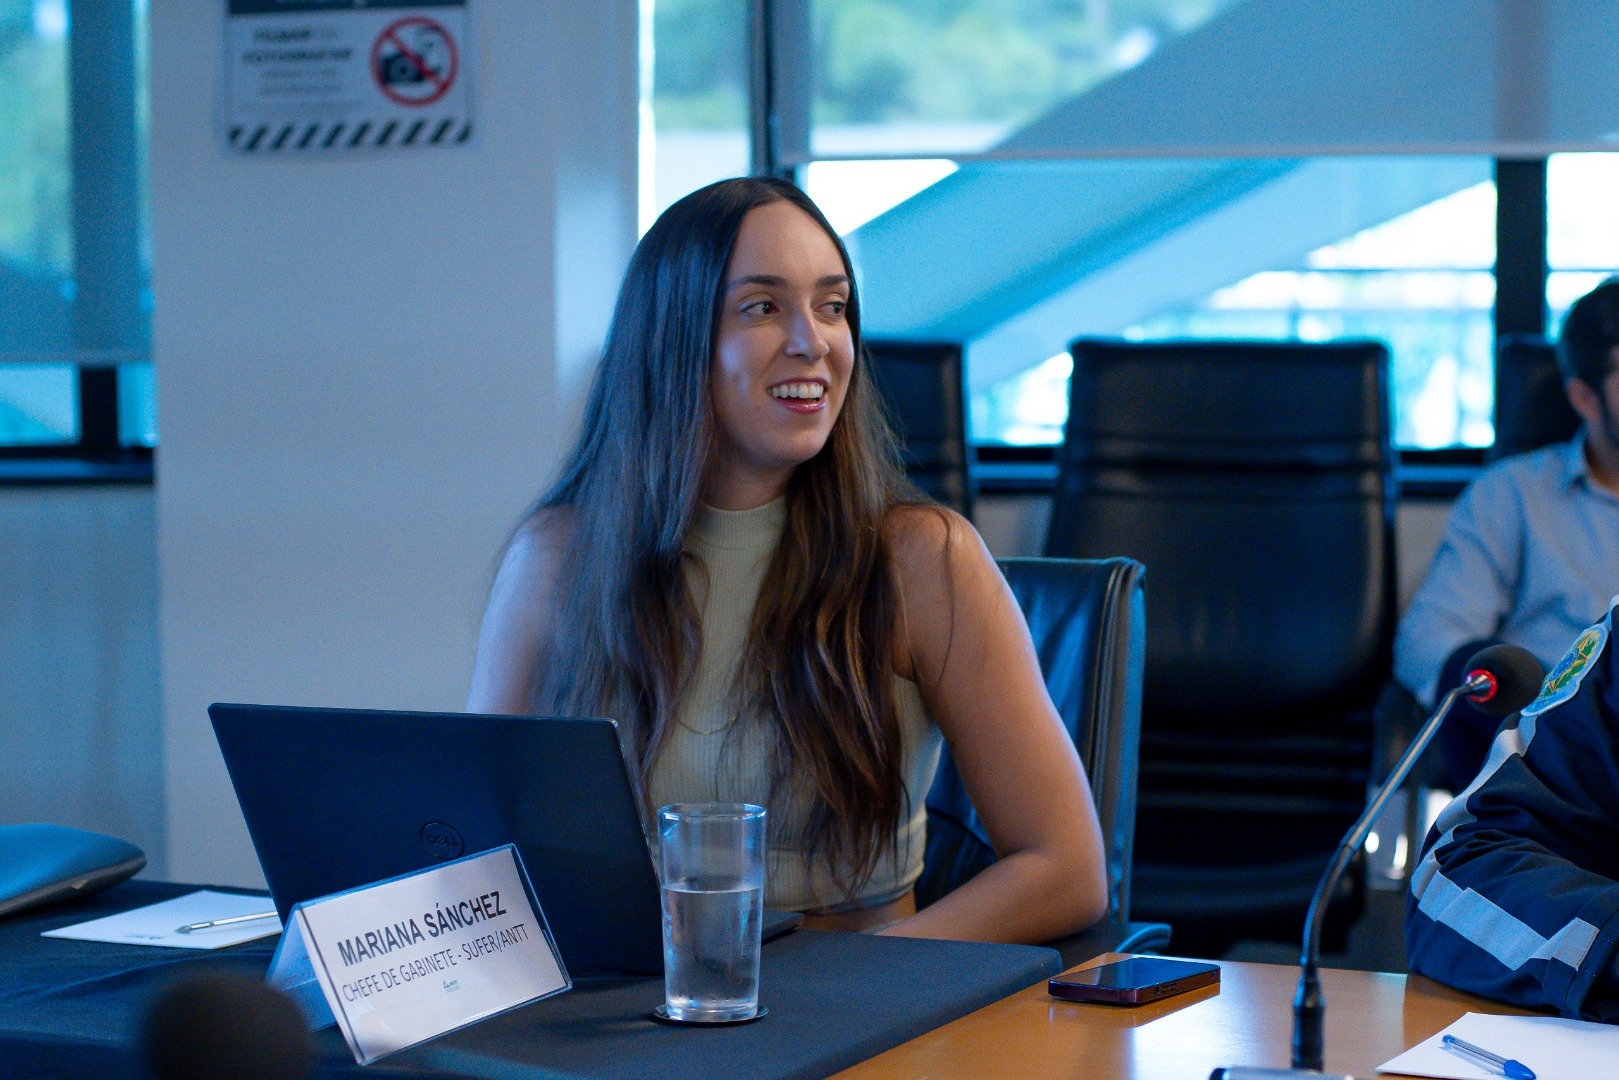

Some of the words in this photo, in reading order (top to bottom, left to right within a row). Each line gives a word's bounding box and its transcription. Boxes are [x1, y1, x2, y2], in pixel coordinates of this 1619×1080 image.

[336, 918, 426, 967] MARIANA
[423, 891, 507, 938] SÁNCHEZ
[342, 974, 383, 1002] CHEFE
[380, 968, 401, 989] DE
[399, 948, 458, 982] GABINETE
[461, 923, 529, 961] SUFER/ANTT
